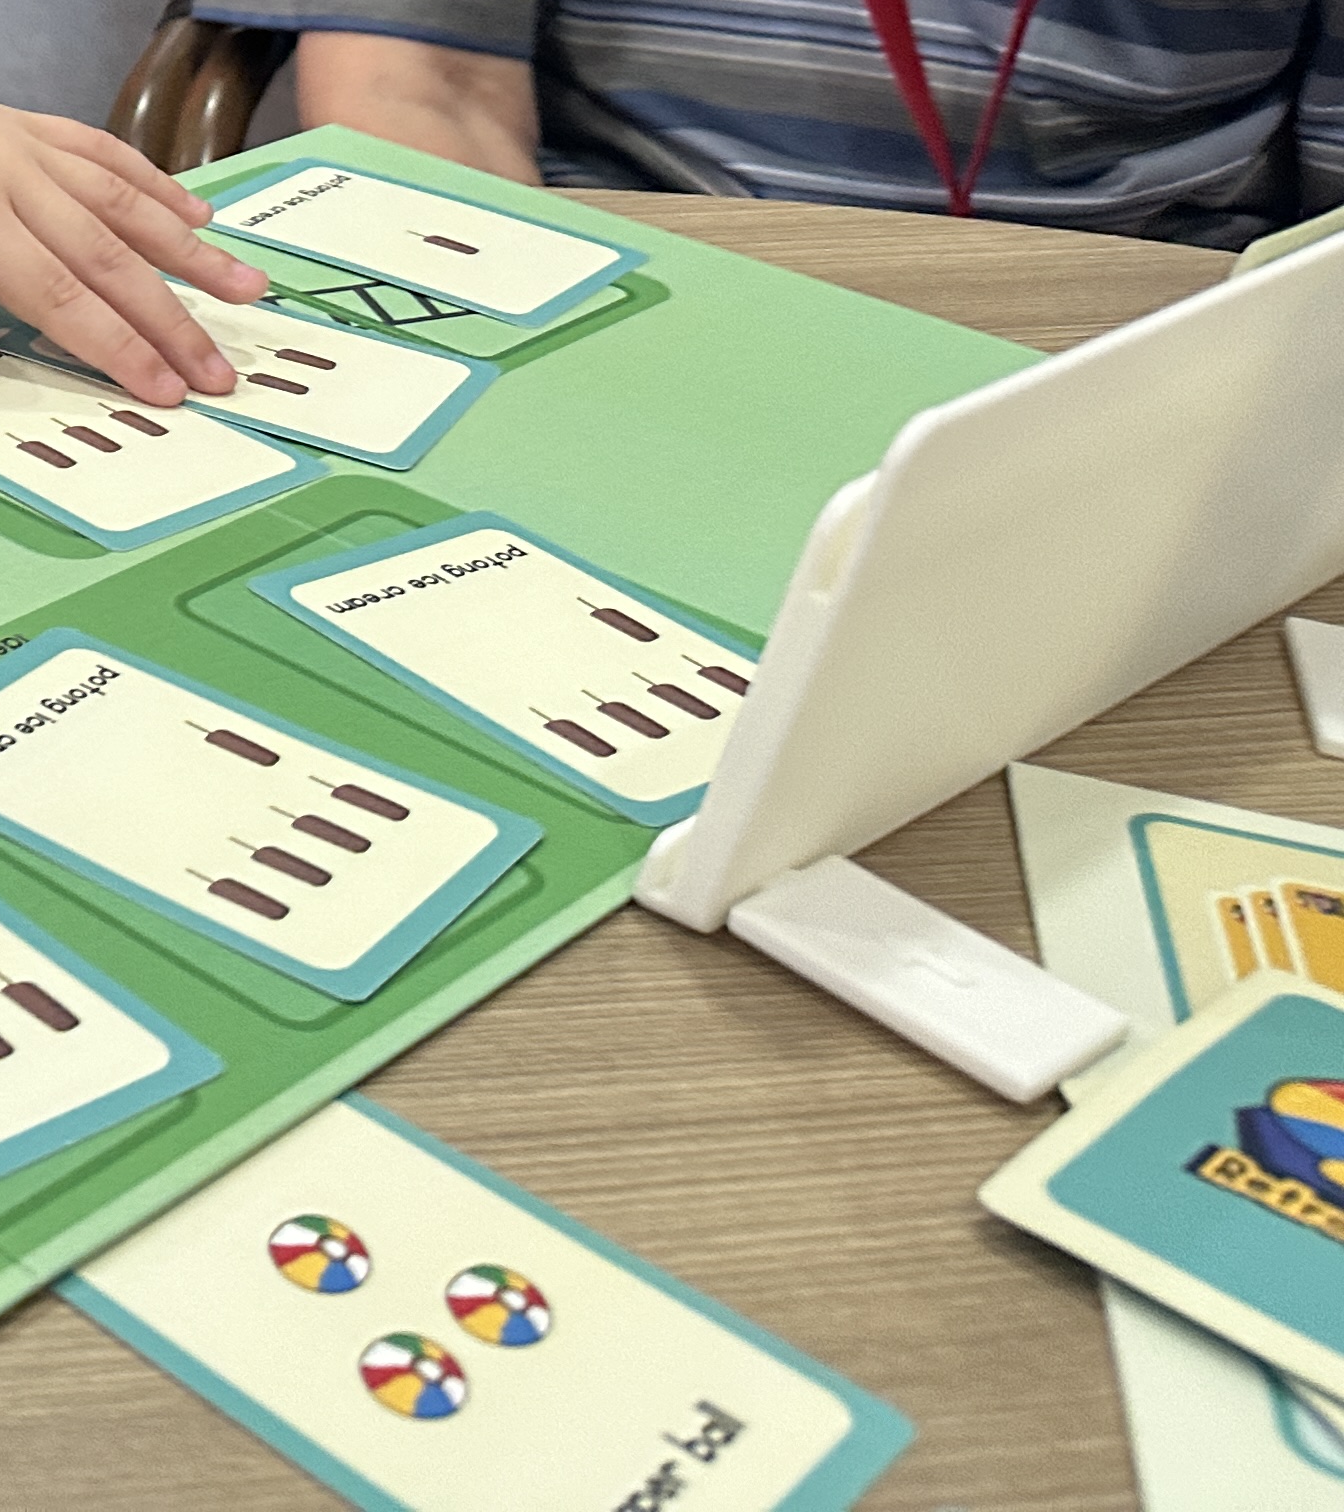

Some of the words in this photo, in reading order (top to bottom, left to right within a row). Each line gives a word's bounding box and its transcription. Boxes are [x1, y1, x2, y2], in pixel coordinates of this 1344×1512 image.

[298, 173, 352, 197] potong
[282, 195, 312, 207] ice
[238, 205, 287, 227] cream
[440, 544, 528, 578] potong
[407, 573, 451, 589] ice
[325, 585, 406, 614] cream
[39, 664, 121, 714] potong
[14, 711, 57, 734] ice
